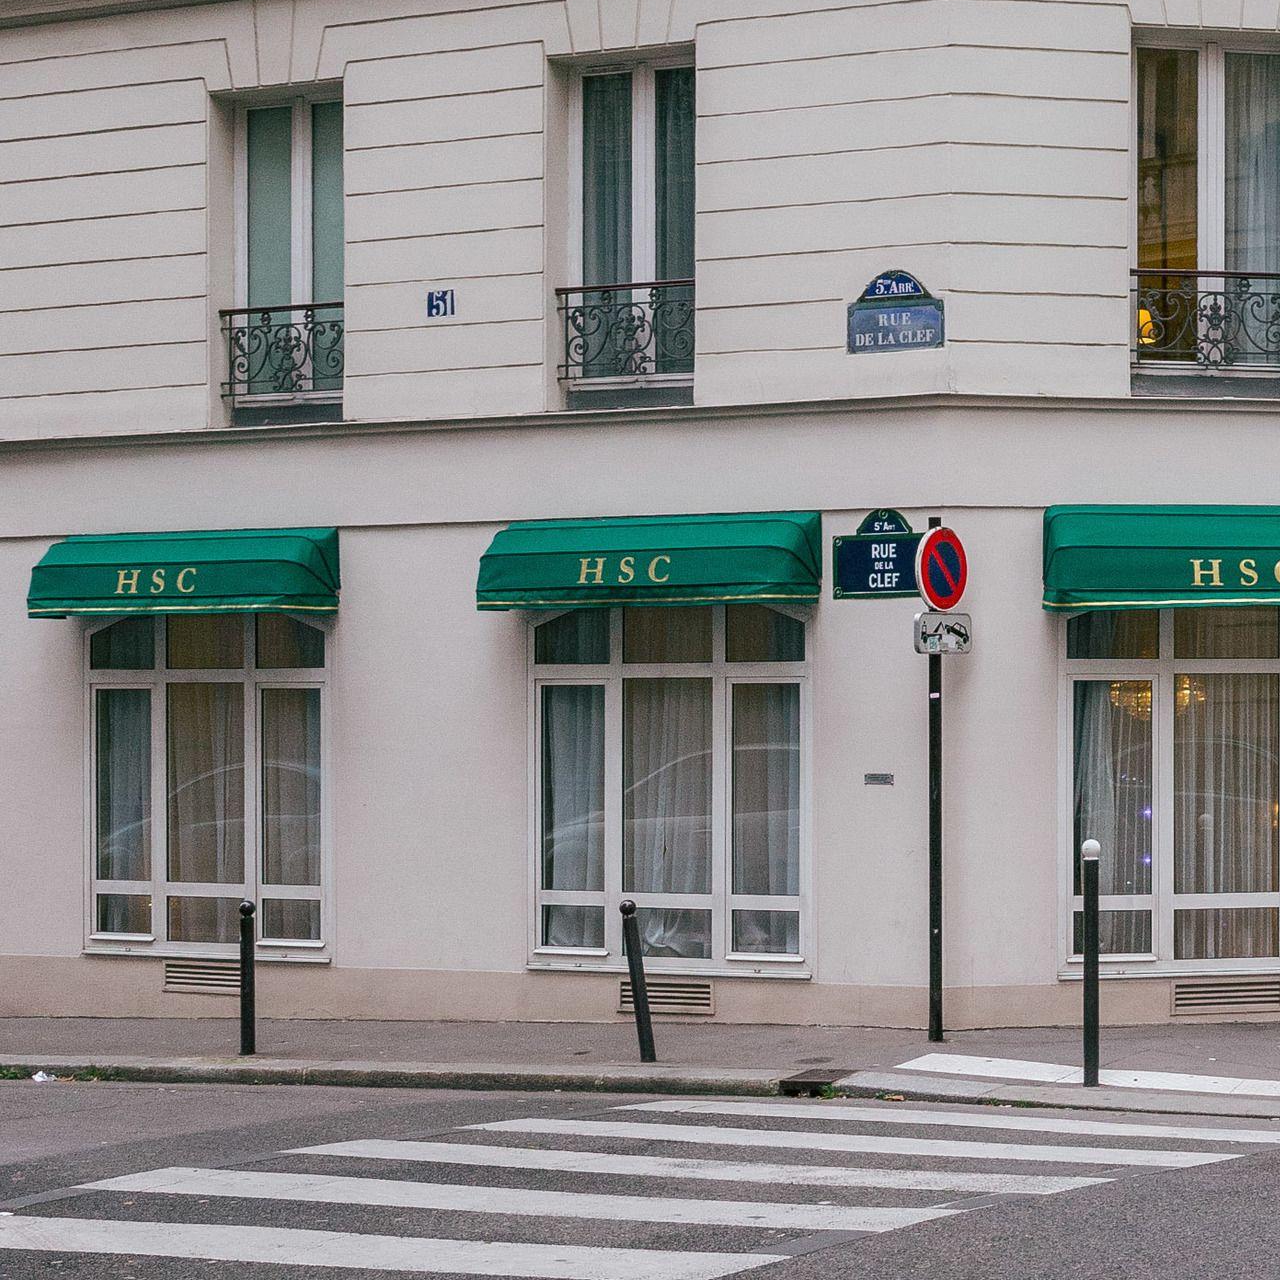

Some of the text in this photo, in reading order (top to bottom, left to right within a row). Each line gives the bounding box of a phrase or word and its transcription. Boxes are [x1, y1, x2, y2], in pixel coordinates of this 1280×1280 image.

[432, 290, 452, 317] 51
[878, 312, 911, 327] RUE
[855, 329, 935, 346] DE LA CLEF
[871, 543, 897, 559] RUE
[874, 561, 893, 570] DE LA
[868, 573, 900, 588] CLEF
